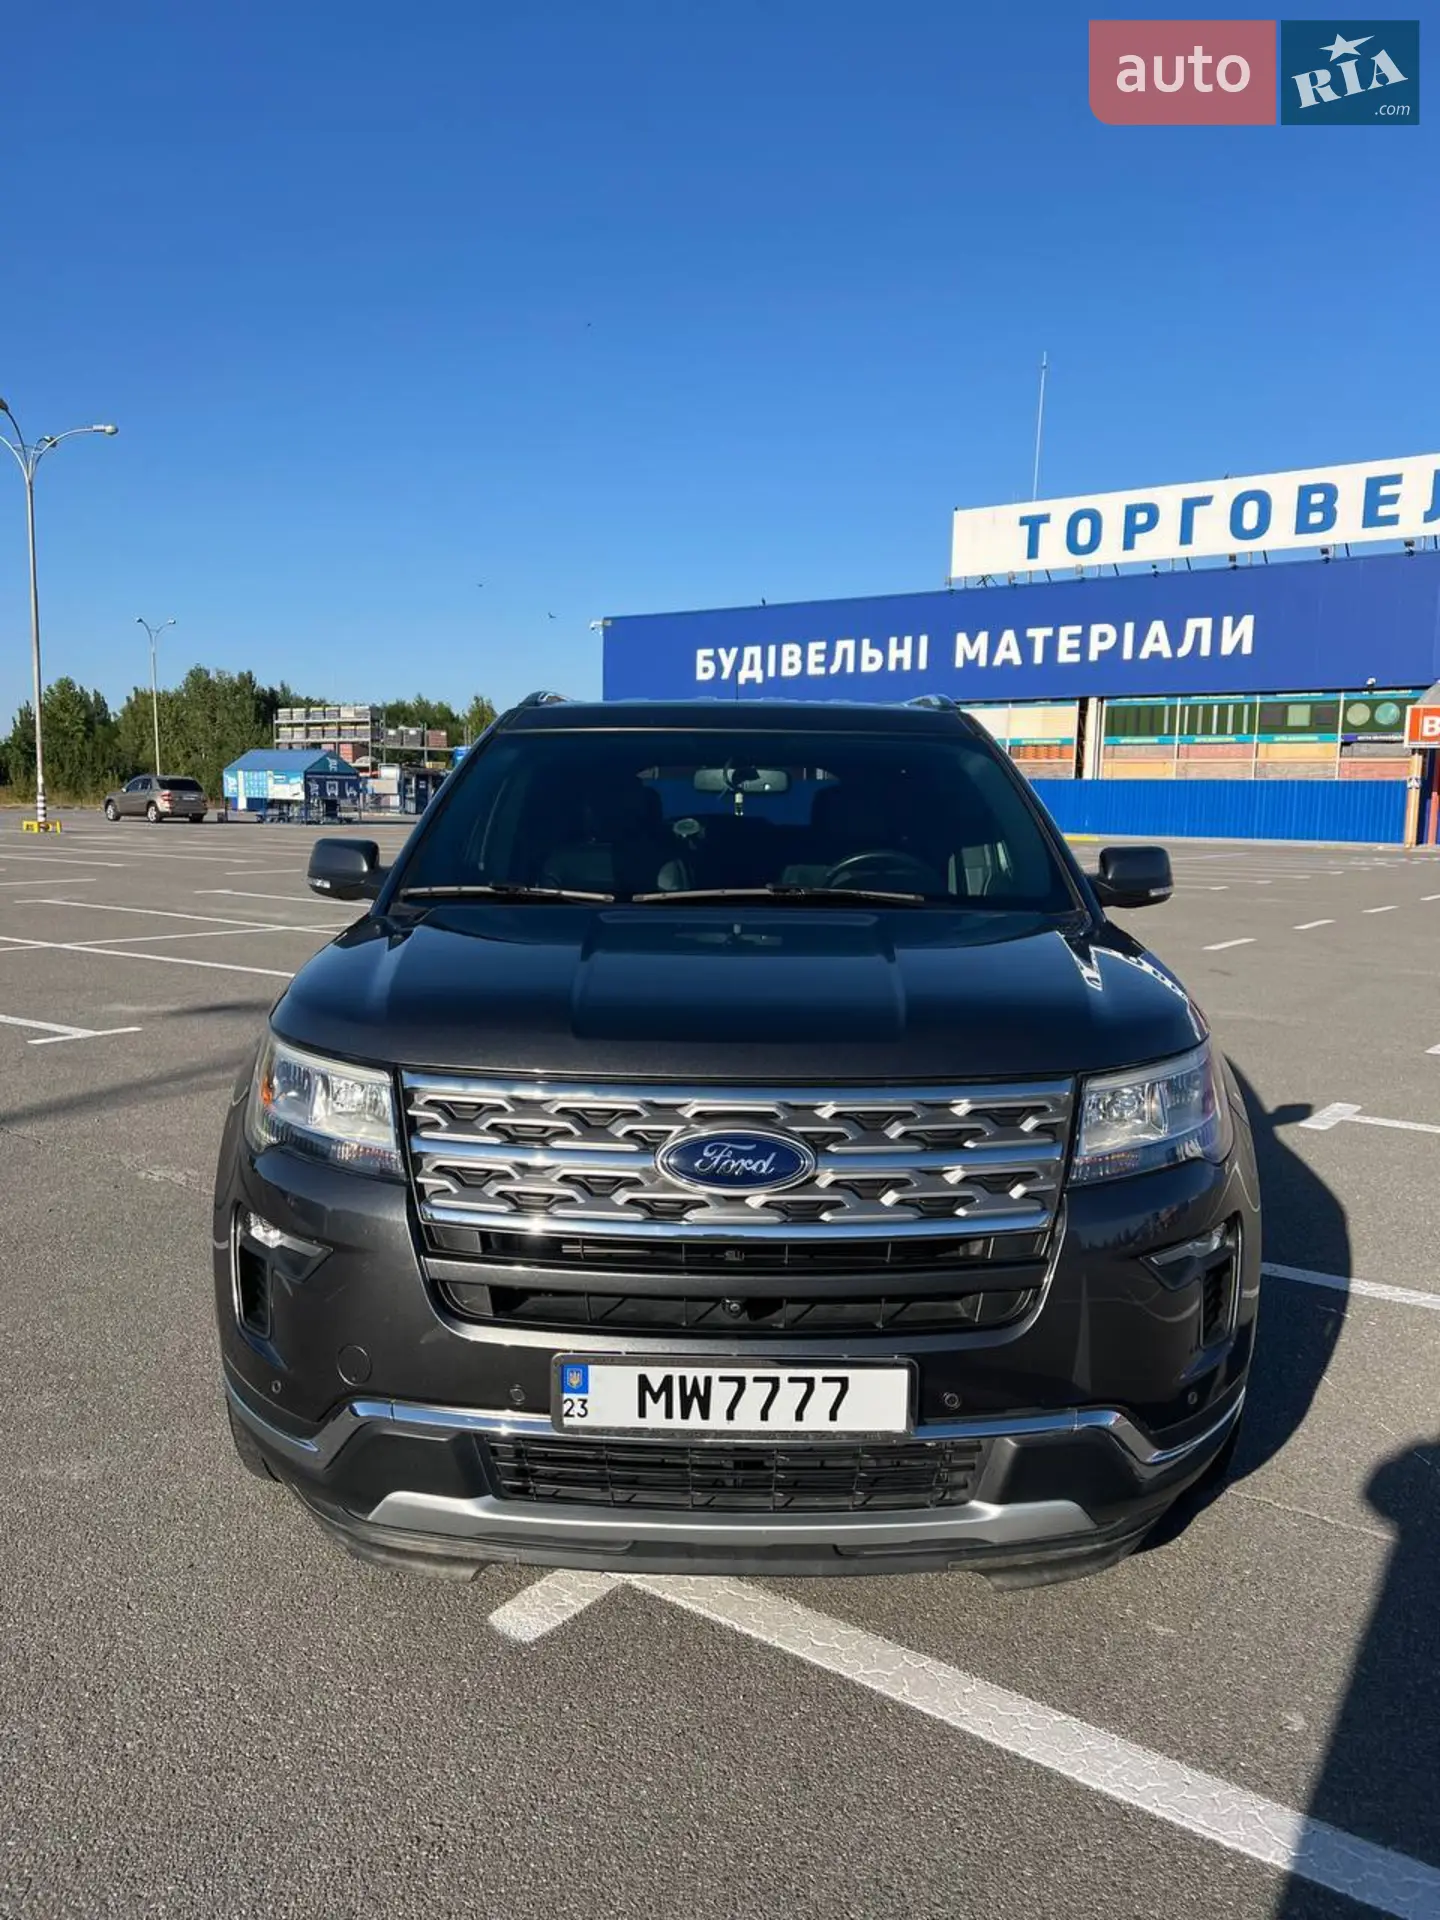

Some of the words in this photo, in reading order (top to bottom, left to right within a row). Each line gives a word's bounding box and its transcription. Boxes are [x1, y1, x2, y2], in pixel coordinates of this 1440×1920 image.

[696, 634, 929, 685] БУДІВЕЛЬНІ
[954, 614, 1255, 669] МАТЕРІАЛИ
[694, 1142, 776, 1175] Ford
[563, 1398, 588, 1418] 23
[637, 1373, 850, 1422] MW7777
